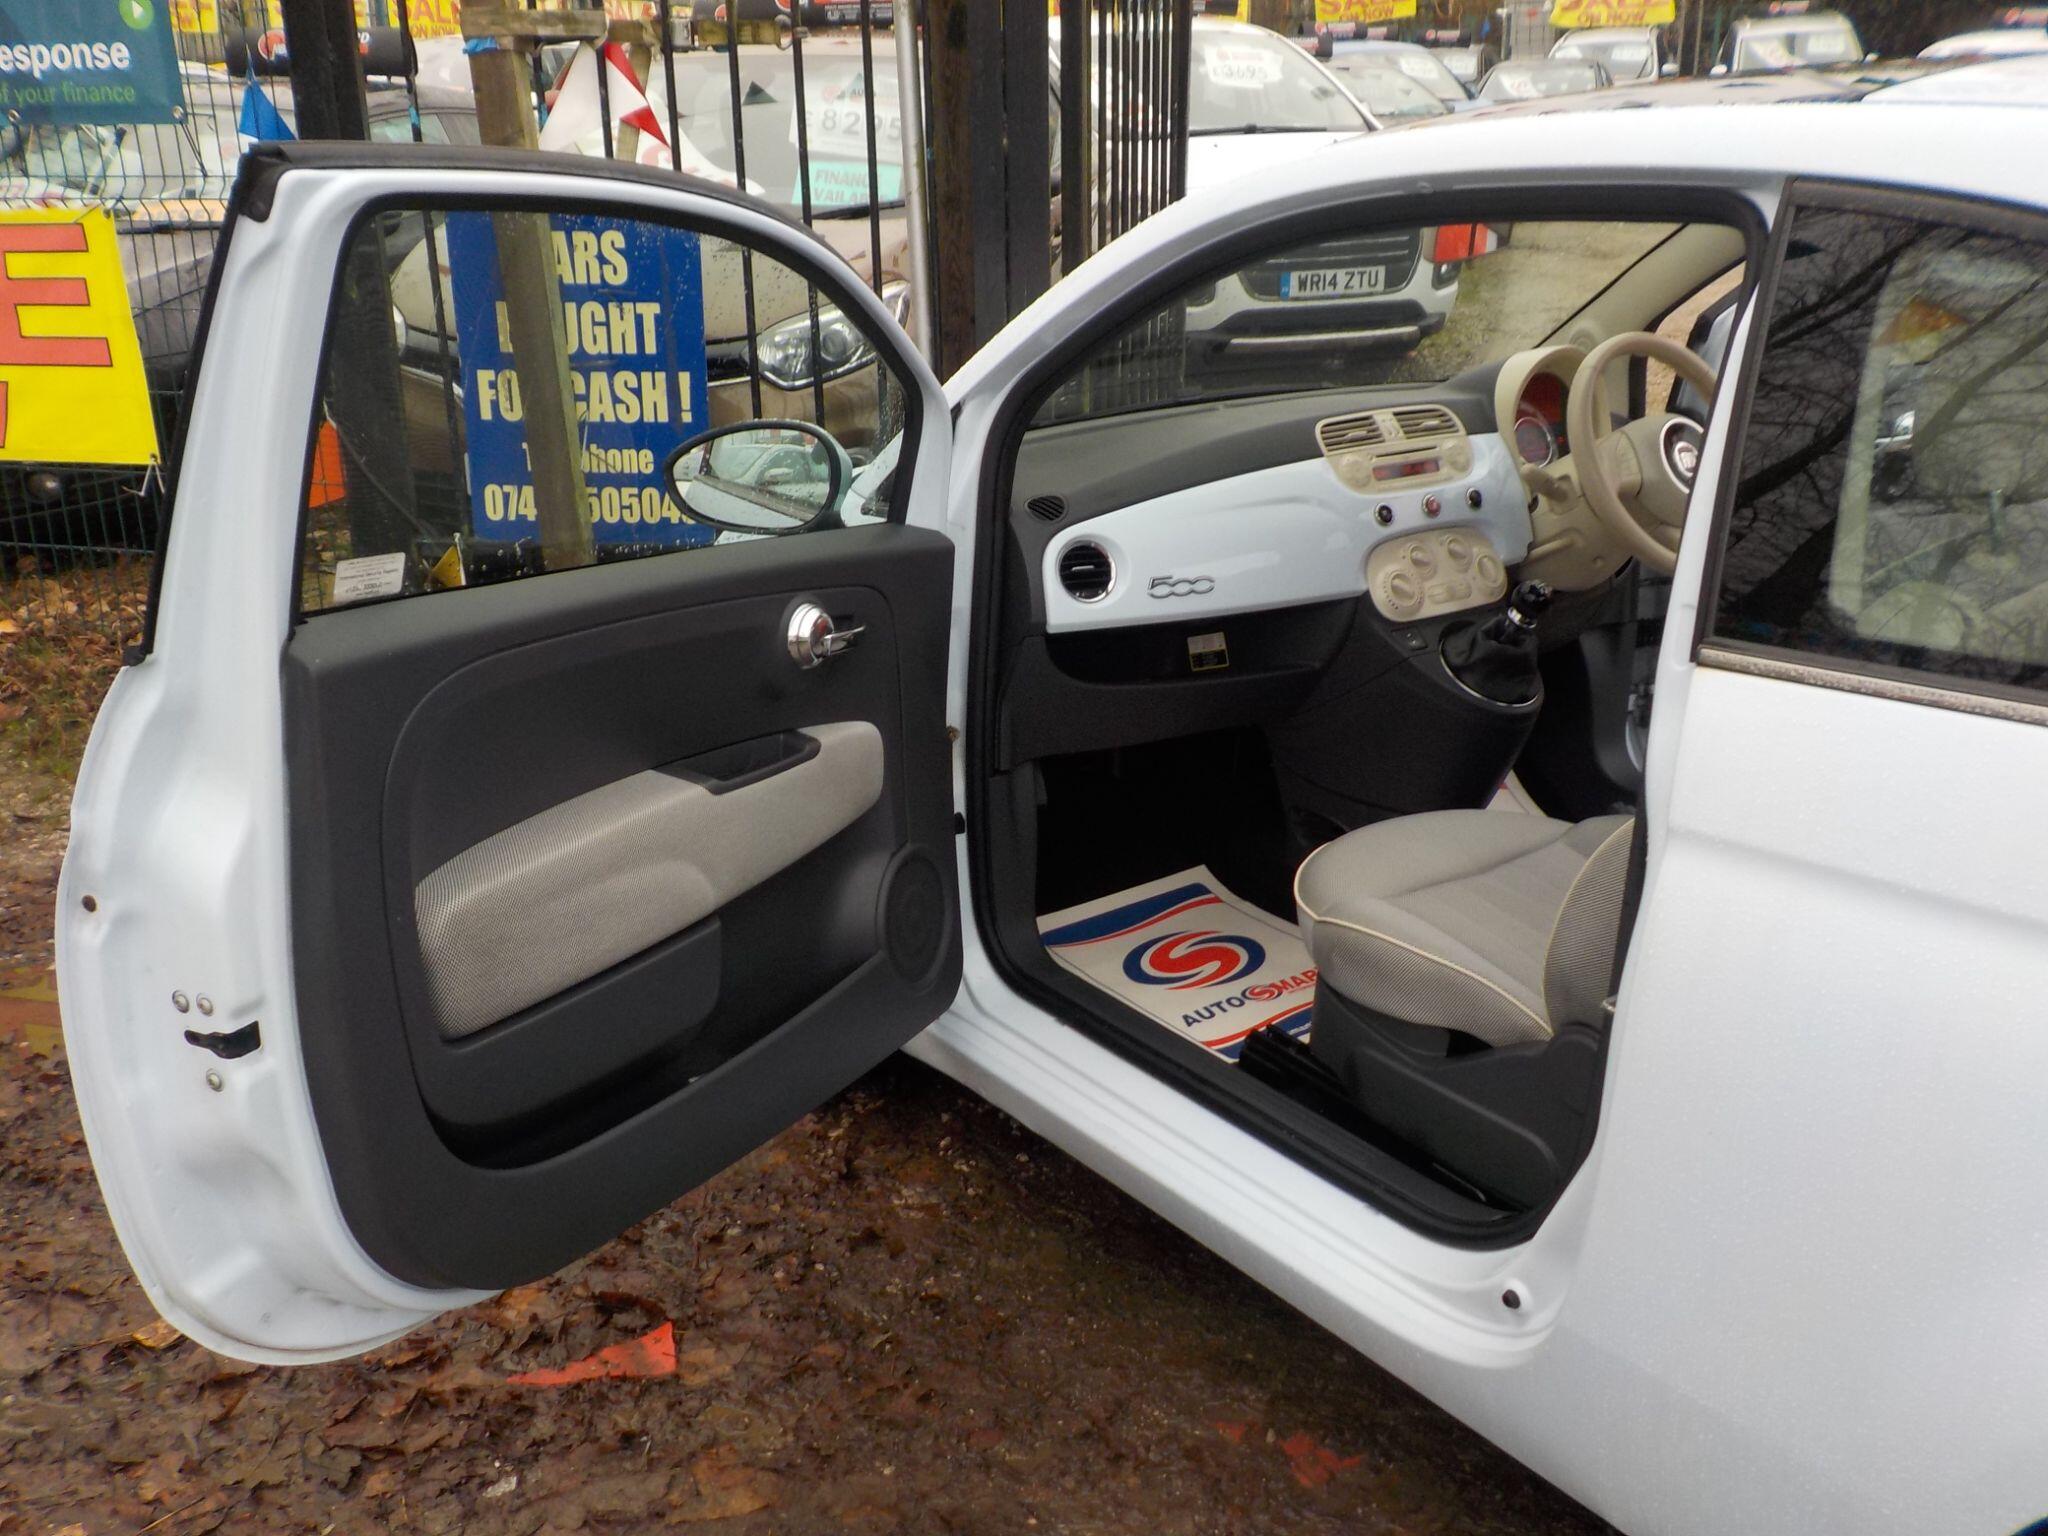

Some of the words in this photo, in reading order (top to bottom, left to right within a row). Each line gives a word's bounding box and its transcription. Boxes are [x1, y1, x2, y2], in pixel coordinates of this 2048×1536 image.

[14, 85, 56, 108] your
[62, 81, 136, 105] finance
[551, 229, 628, 285] ARS
[1298, 272, 1338, 293] WR14
[1344, 269, 1379, 290] ZTU
[476, 369, 524, 422] FO
[571, 371, 669, 424] CASH
[1147, 575, 1215, 599] 500
